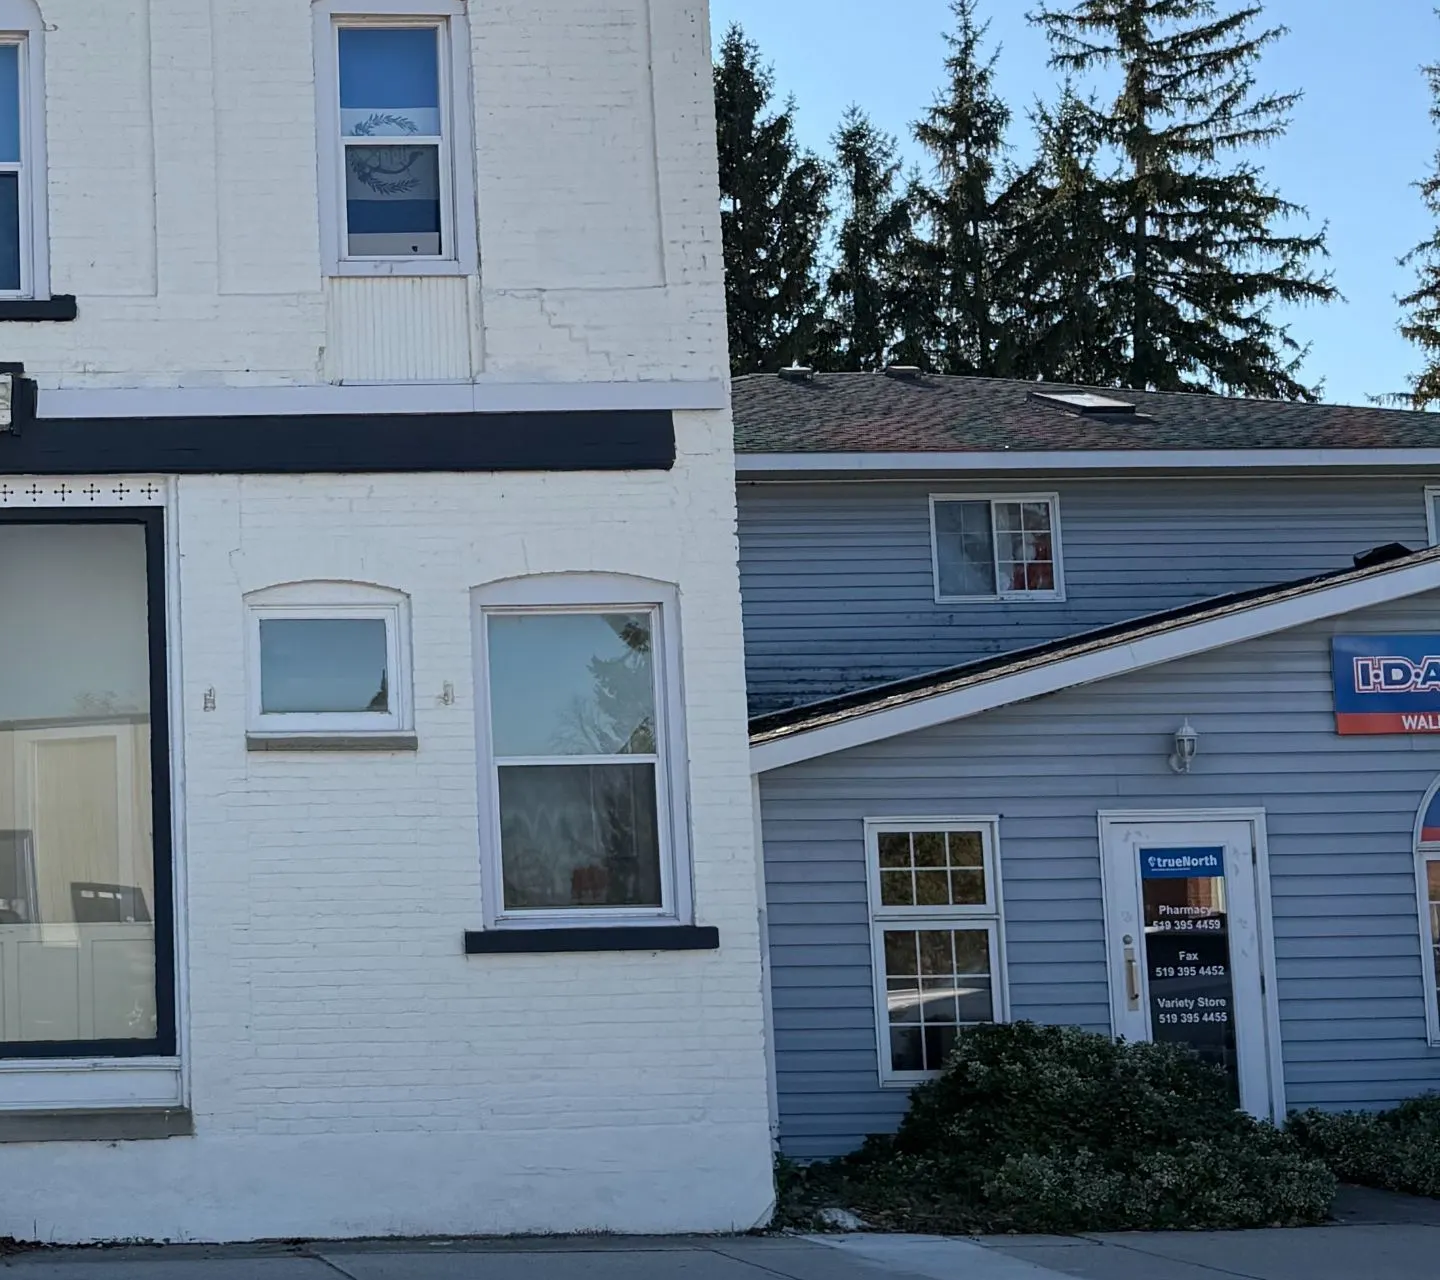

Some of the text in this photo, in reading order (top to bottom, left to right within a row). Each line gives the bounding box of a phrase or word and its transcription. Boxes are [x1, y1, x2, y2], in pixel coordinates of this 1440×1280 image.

[1402, 714, 1440, 730] WAL
[1157, 854, 1218, 868] trueNorth
[1158, 904, 1212, 916] Pharmacy
[1152, 919, 1221, 930] 519 395 4459
[1178, 951, 1199, 961] Fax
[1155, 965, 1225, 977] 519 395 4452
[1157, 996, 1227, 1010] Variety Store
[1158, 1011, 1228, 1024] 519 395 4455
